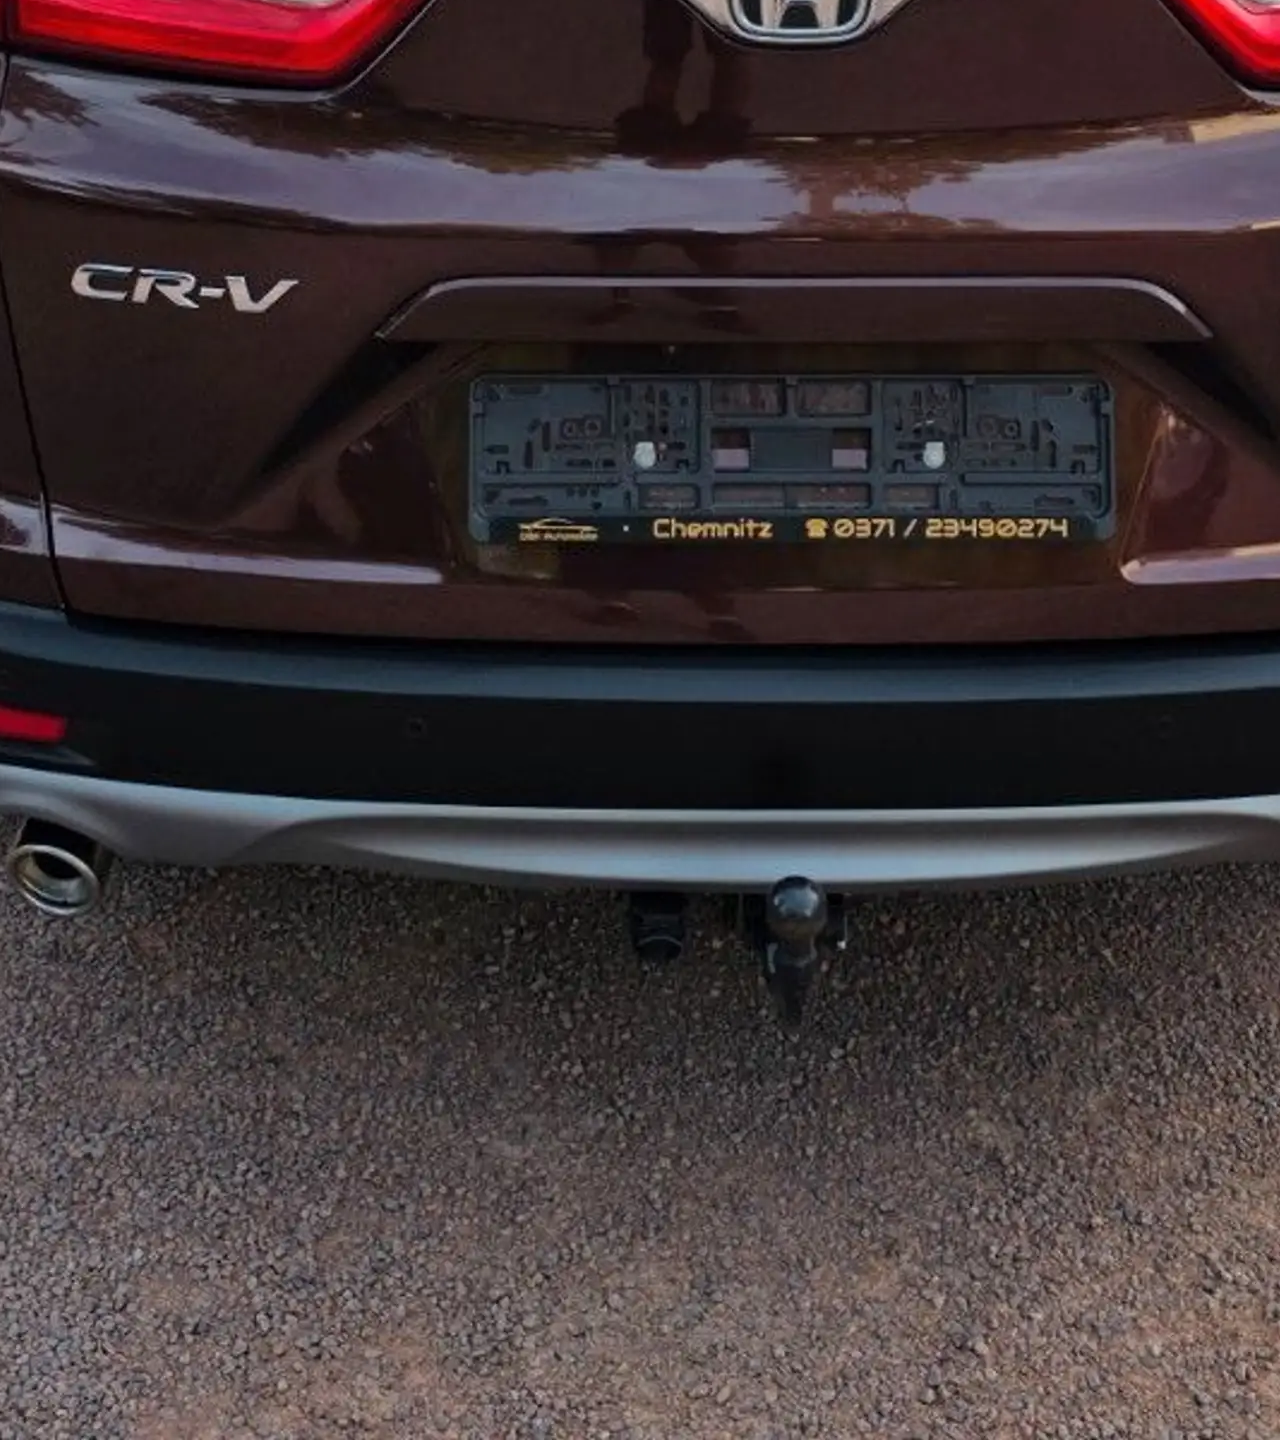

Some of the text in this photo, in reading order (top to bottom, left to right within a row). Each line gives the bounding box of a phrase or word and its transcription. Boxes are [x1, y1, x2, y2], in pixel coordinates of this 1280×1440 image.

[70, 263, 299, 312] CR-V
[652, 517, 773, 539] Chemnitz
[833, 518, 895, 539] 0371
[925, 518, 1069, 539] 23490274
